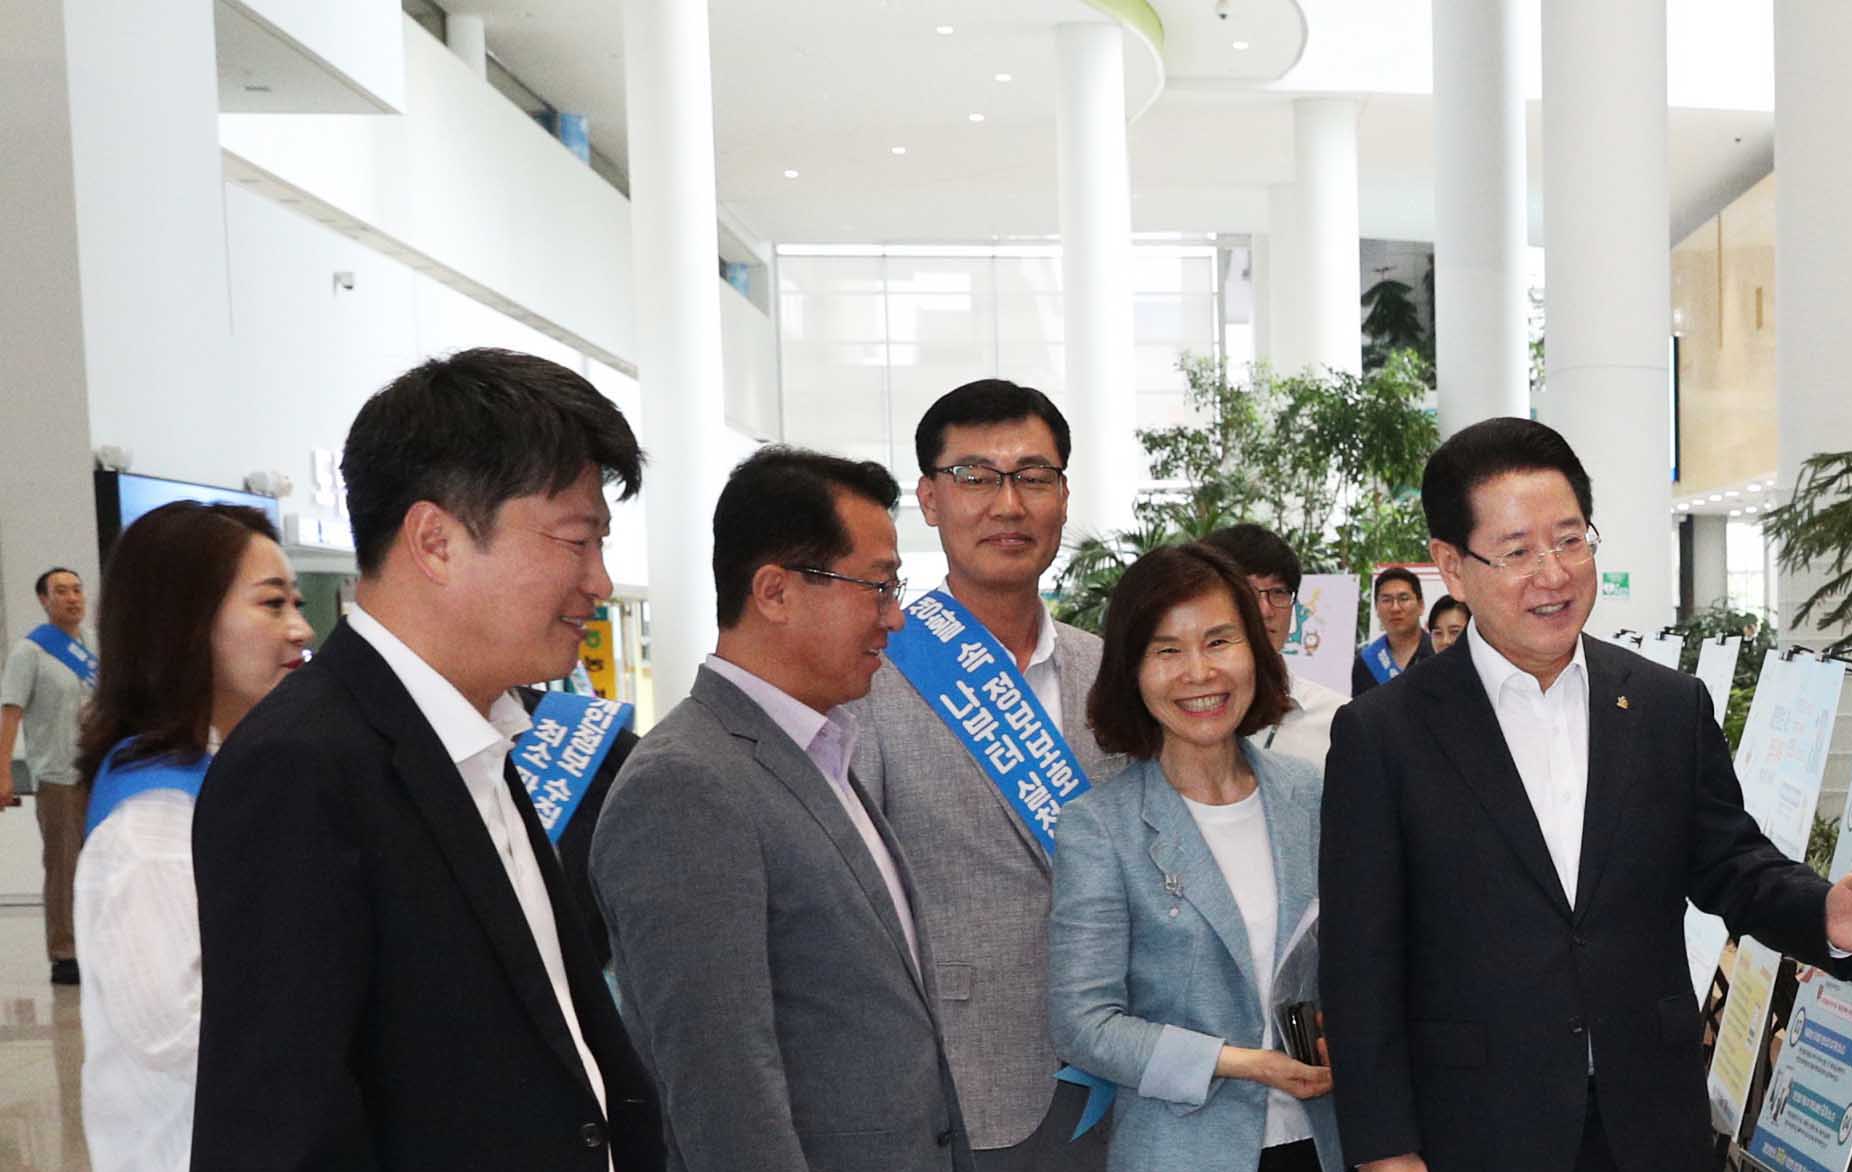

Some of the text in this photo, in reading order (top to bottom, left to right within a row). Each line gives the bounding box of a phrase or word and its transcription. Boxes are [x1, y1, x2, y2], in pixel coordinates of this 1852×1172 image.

[521, 718, 568, 769] 최소
[940, 680, 1025, 774] 나부터
[956, 641, 996, 672] 속
[981, 671, 1079, 797] 정보보호
